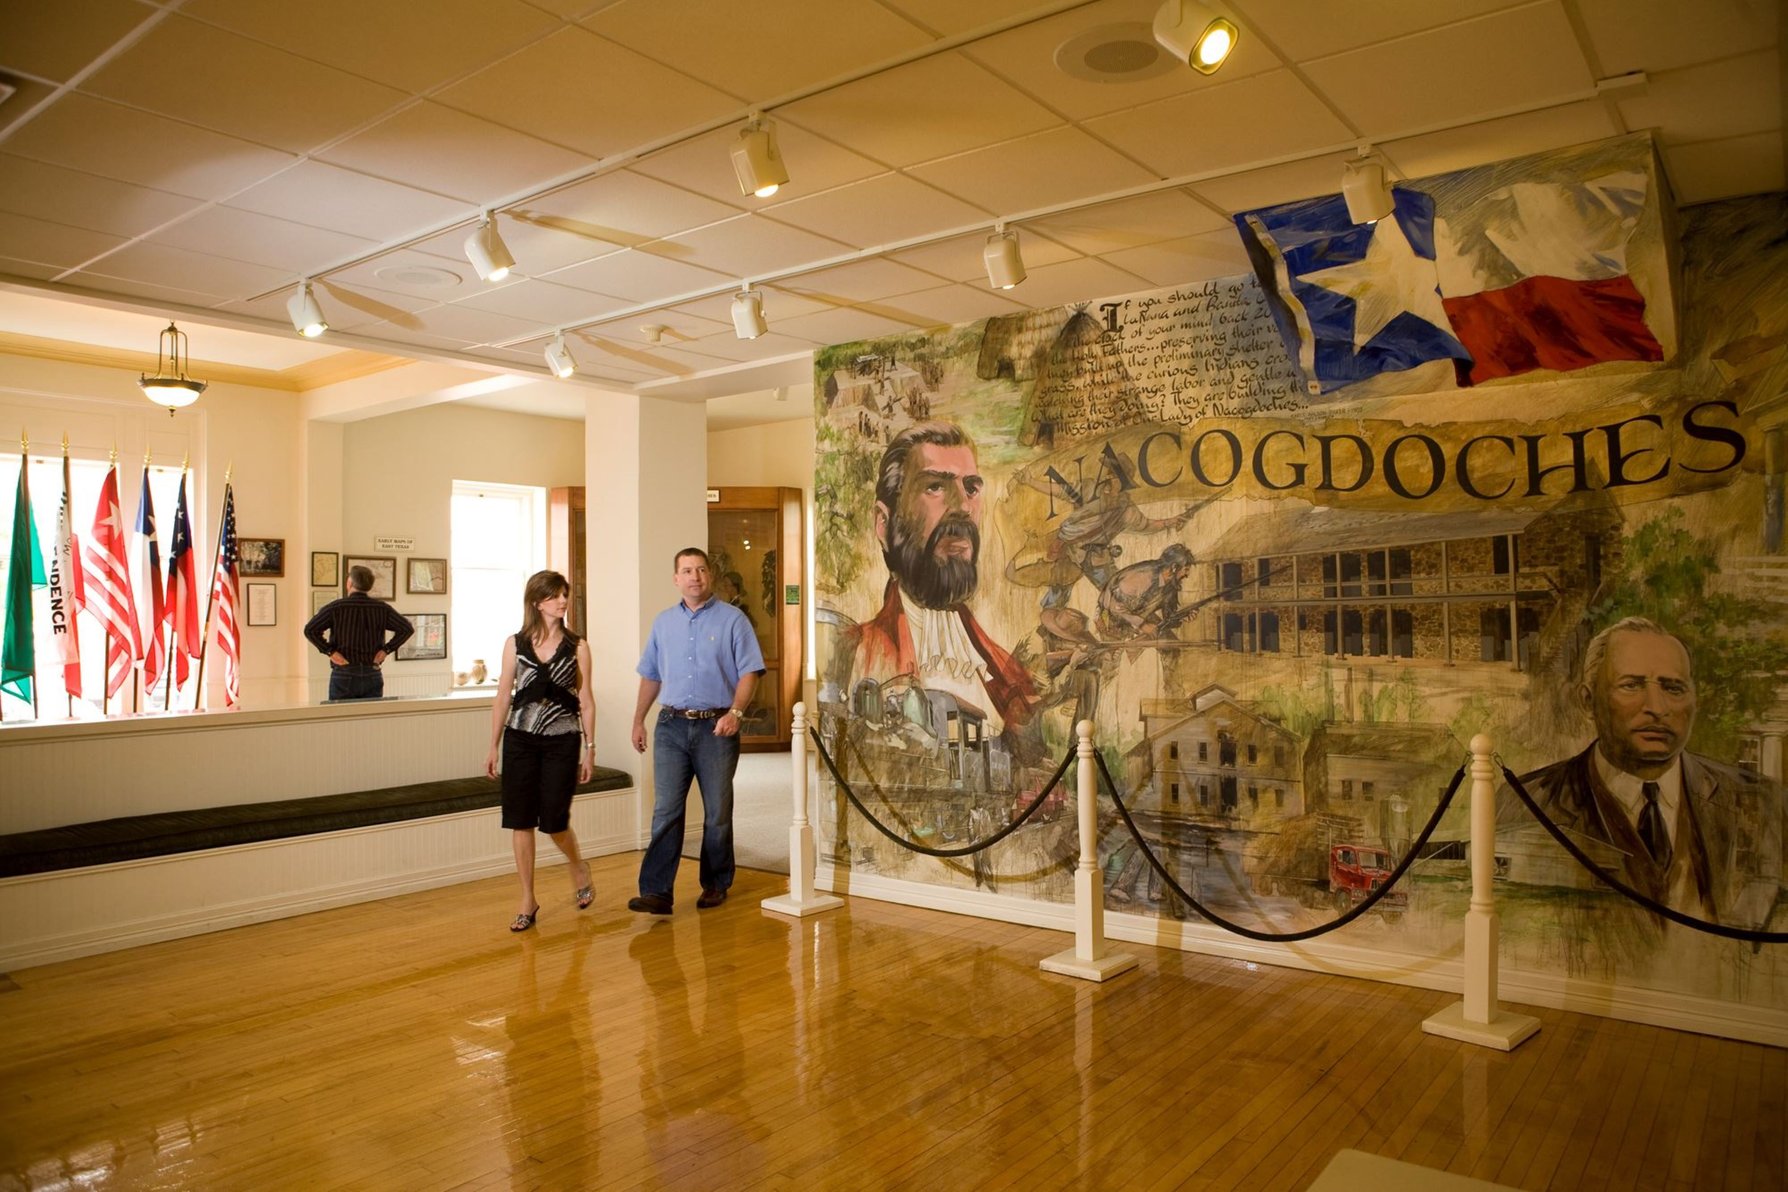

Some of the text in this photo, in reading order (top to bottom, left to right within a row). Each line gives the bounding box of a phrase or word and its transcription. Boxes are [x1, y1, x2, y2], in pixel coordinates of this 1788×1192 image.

[1138, 297, 1162, 313] you
[1167, 281, 1220, 304] should
[1228, 281, 1245, 299] go
[1173, 300, 1202, 317] and
[1130, 327, 1144, 340] of
[1146, 325, 1176, 341] your
[1180, 312, 1213, 330] mind
[1219, 311, 1248, 325] back
[1232, 323, 1263, 339] their
[1106, 360, 1123, 375] up
[1128, 355, 1148, 368] the
[1225, 340, 1273, 357] shelter
[1121, 370, 1143, 382] the
[1146, 366, 1198, 381] curious
[1204, 356, 1260, 373] Indians
[1087, 388, 1114, 403] their
[1117, 384, 1166, 400] strange
[1172, 377, 1205, 393] labor
[1209, 371, 1235, 388] and
[1236, 368, 1278, 390] gentle
[1089, 404, 1118, 419] they
[1171, 390, 1200, 410] They
[1204, 393, 1225, 403] are
[1228, 383, 1287, 401] building
[1056, 419, 1111, 436] Mission
[1132, 410, 1157, 426] Our
[1160, 406, 1193, 426] Lady
[1195, 404, 1208, 419] of
[1042, 400, 1749, 522] NACOGDOCHES
